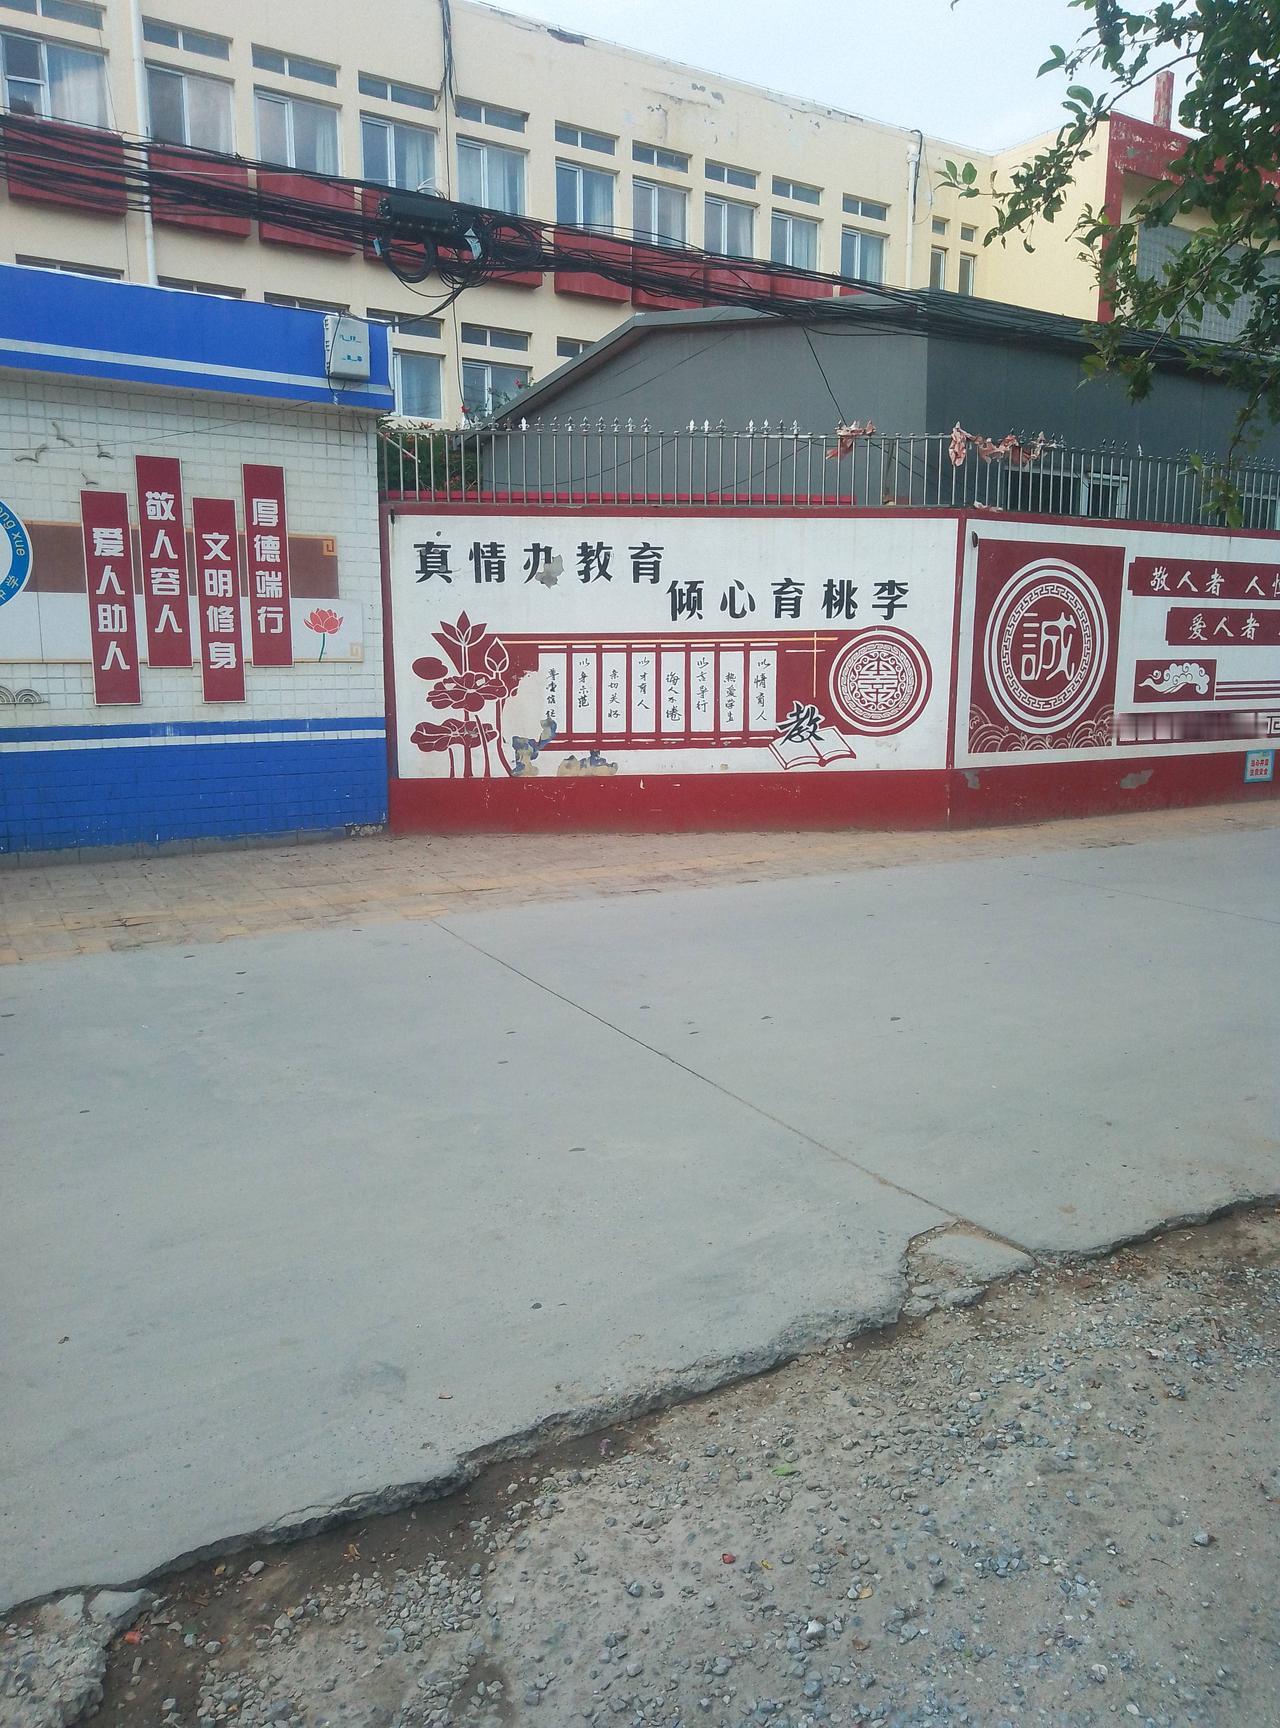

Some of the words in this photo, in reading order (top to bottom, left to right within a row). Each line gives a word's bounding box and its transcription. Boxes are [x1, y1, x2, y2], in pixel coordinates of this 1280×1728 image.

[146, 491, 182, 634] 敬人容人
[252, 498, 284, 635] 厚德端行
[413, 541, 665, 585] 真情办教育
[1150, 566, 1225, 596] 敬人者
[92, 527, 130, 671] 爱人助人
[202, 532, 236, 670] 文明修身
[666, 577, 909, 621] 倾心育桃李
[1187, 612, 1260, 641] 爱人者
[636, 656, 651, 711] 以才育人
[753, 658, 772, 722] 以情育人
[778, 703, 825, 746] 教
